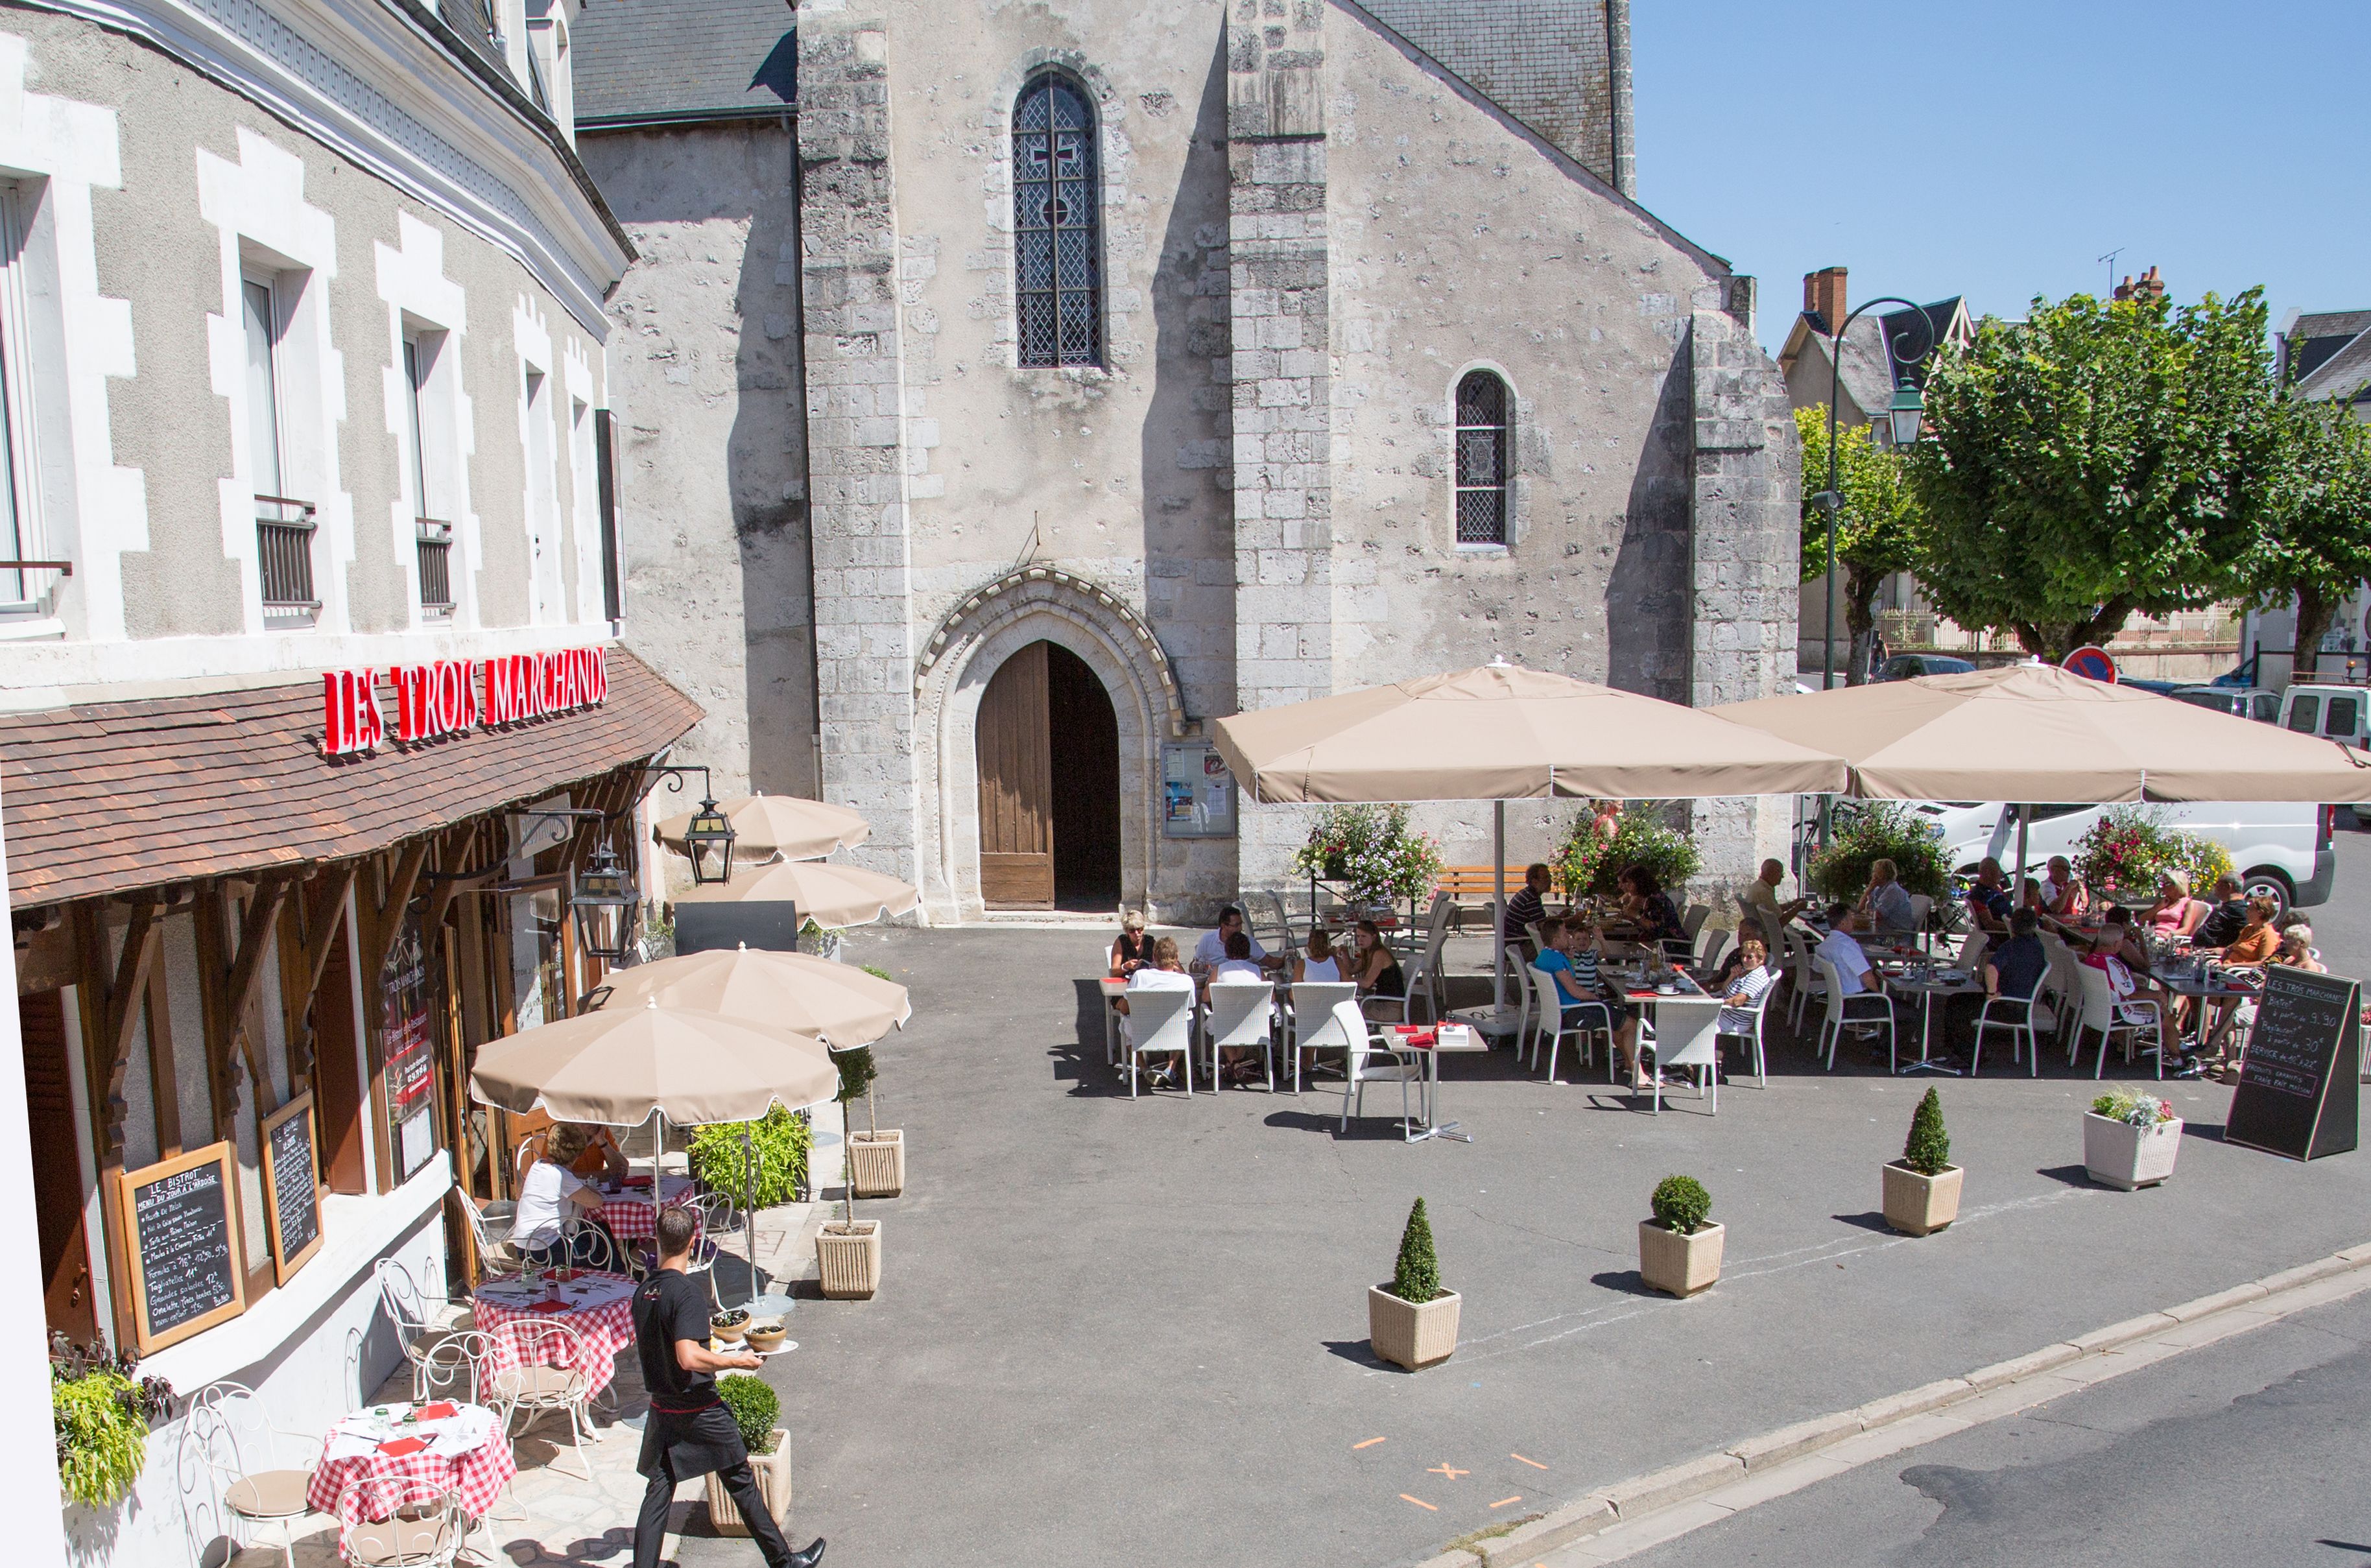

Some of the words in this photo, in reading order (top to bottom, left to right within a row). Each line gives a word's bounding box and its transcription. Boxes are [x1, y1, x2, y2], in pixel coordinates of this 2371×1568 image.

[323, 667, 384, 755] LES
[391, 659, 479, 741] TROIS
[484, 647, 608, 726] MARCHANDS
[2267, 979, 2282, 991] LES
[2286, 982, 2304, 995] TROIS
[2305, 988, 2347, 1003] MARCHANDS
[137, 1198, 154, 1211] MENU
[157, 1194, 165, 1203] DU
[166, 1188, 182, 1199] JOUR
[150, 1290, 178, 1306] Grandes
[180, 1281, 204, 1294] salades
[152, 1301, 180, 1316] Omelette
[180, 1296, 195, 1309] fines
